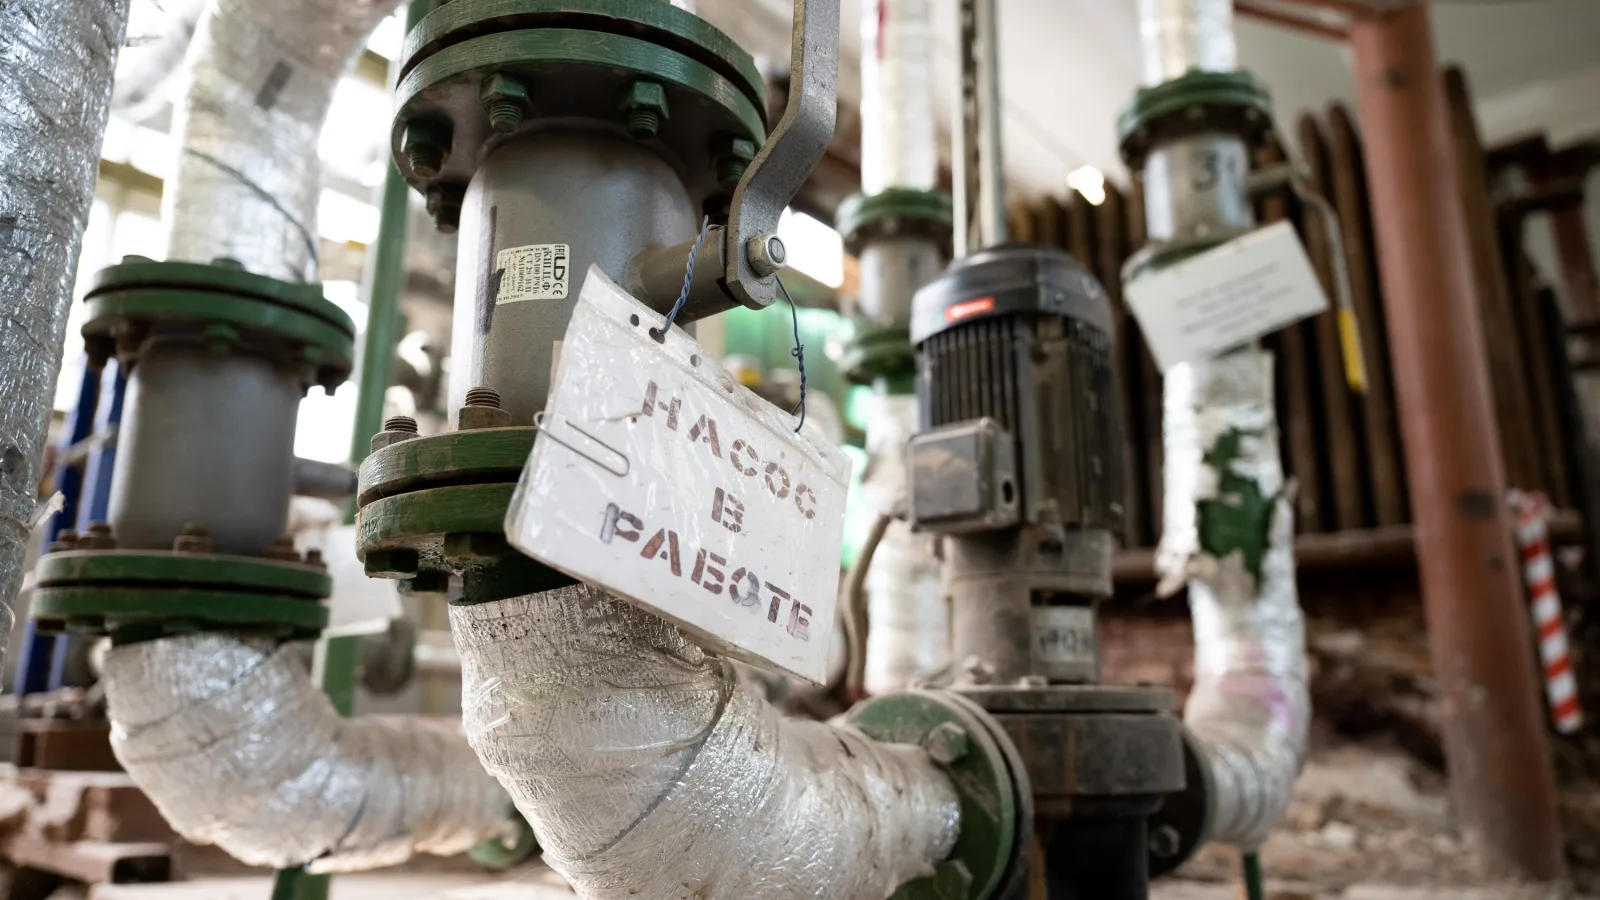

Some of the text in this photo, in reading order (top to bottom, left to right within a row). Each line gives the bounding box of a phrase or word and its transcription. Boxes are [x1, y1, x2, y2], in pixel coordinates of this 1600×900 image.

[642, 379, 817, 519] НАСОС
[711, 486, 744, 533] В
[600, 501, 812, 643] РАБОТЕ
